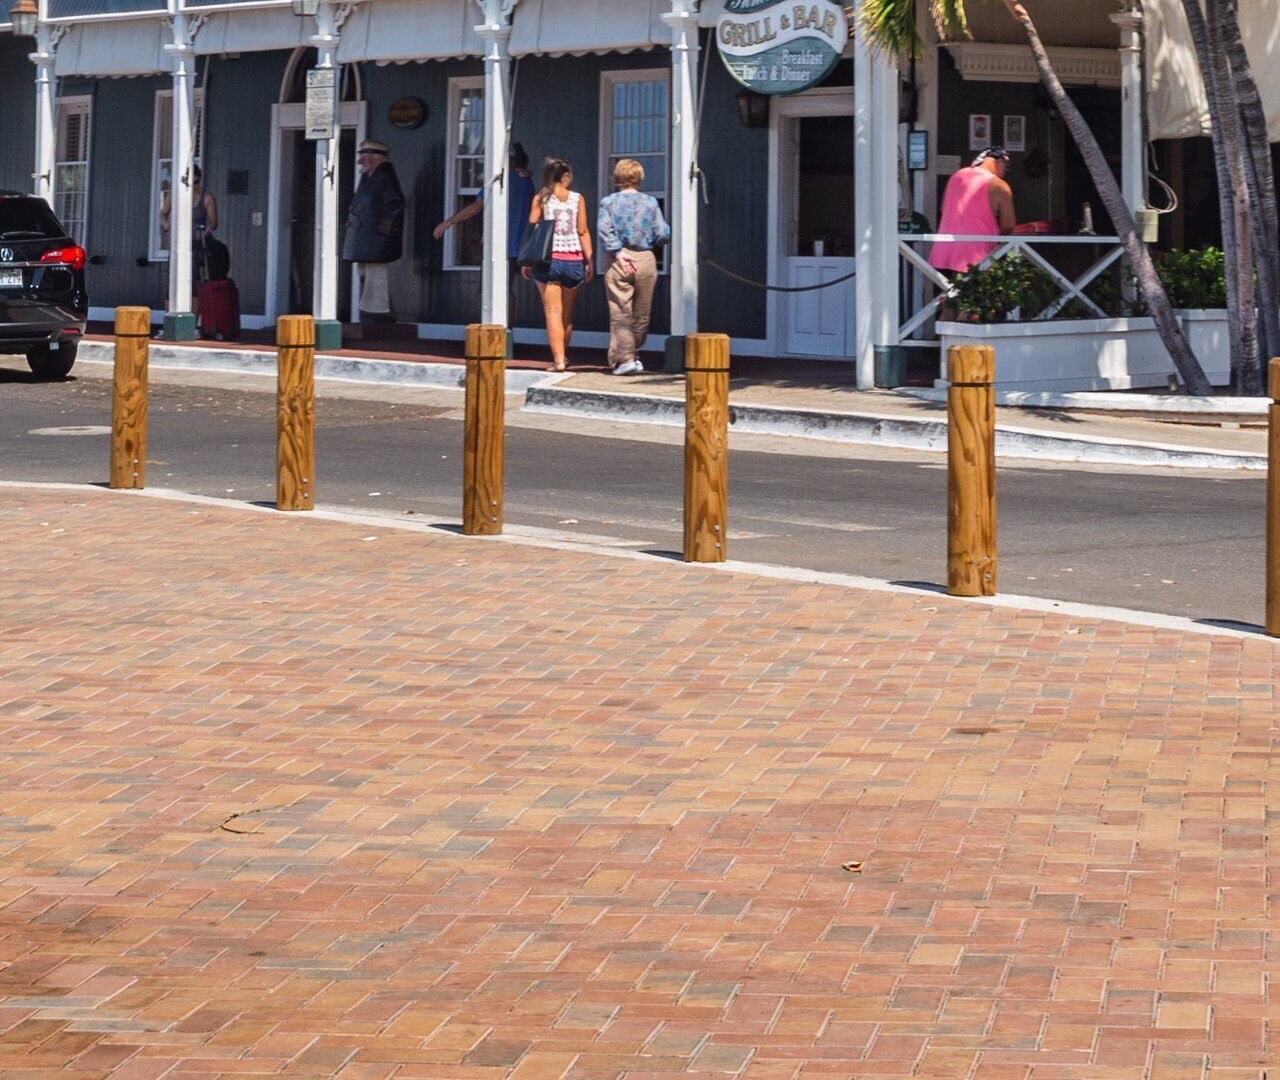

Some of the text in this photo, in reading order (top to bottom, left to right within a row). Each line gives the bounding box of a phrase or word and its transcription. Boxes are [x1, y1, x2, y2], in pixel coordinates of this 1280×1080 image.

[720, 5, 837, 48] GRILL & BAR
[782, 49, 823, 65] Breakfast
[770, 65, 779, 80] &
[781, 65, 812, 81] Dinner
